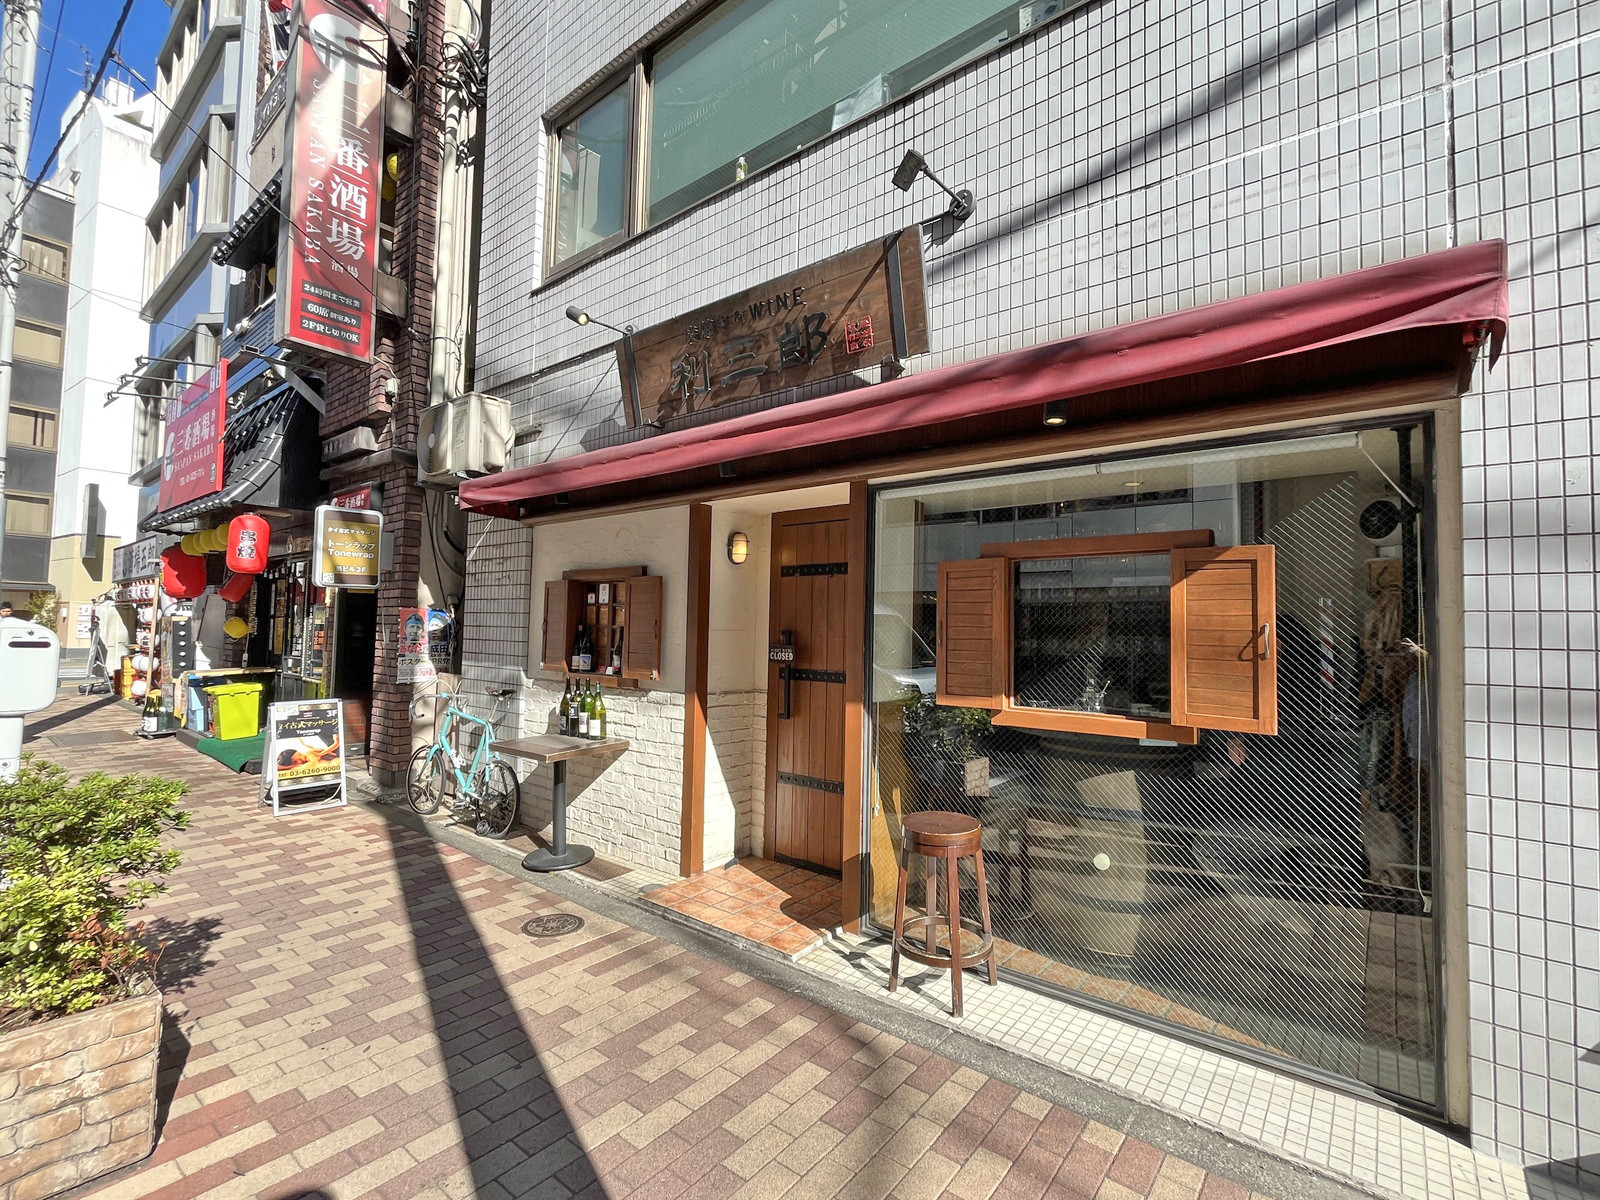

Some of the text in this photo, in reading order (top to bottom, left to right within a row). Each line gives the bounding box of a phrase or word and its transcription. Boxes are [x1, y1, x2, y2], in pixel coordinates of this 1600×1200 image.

[327, 91, 371, 261] 三番酒場
[304, 176, 325, 264] SAKABA
[748, 286, 806, 320] WINE
[302, 319, 359, 343] 2F貸し切りOK
[670, 311, 829, 399] 利三郎
[175, 411, 210, 456] 三番酒場
[328, 548, 374, 559] Tonewrap
[770, 652, 793, 660] CLOSED
[326, 709, 338, 718] 3F
[289, 765, 341, 777] 03-6260-9000
